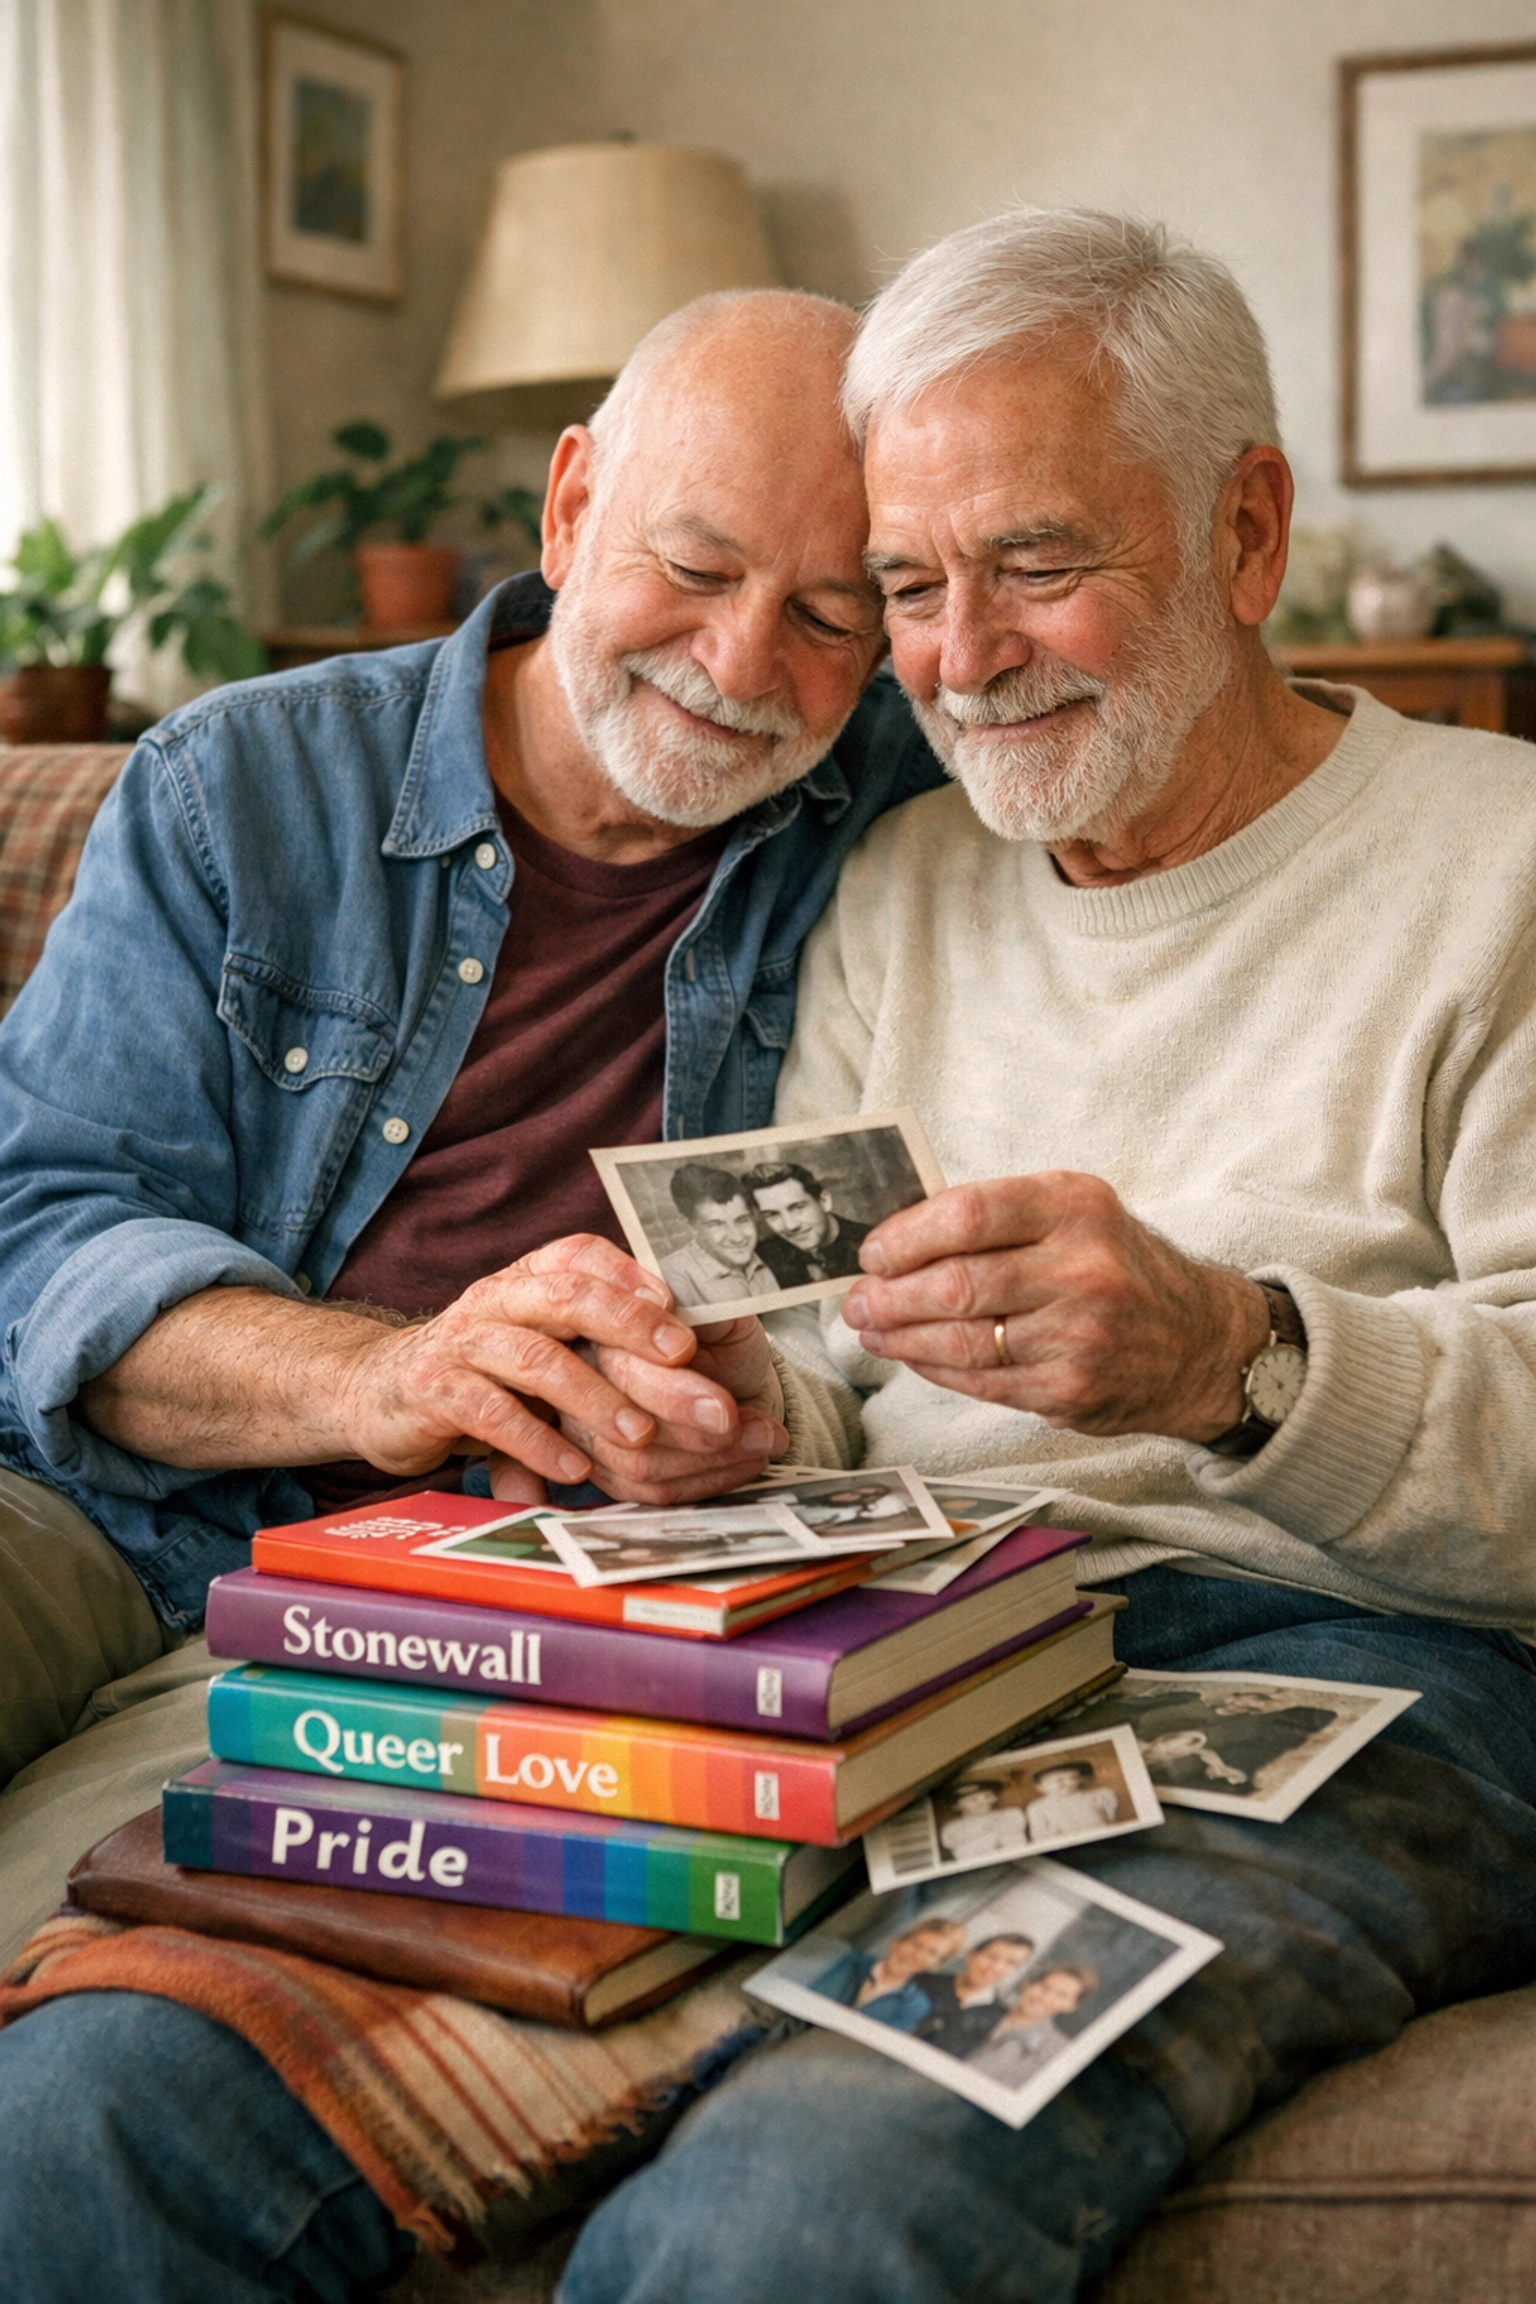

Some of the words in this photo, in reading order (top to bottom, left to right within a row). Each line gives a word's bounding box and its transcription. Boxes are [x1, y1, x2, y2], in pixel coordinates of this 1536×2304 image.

[283, 1605, 542, 1685] Stonewall
[293, 1709, 463, 1775] Queer
[485, 1734, 618, 1797] Love
[271, 1808, 469, 1888] Pride
